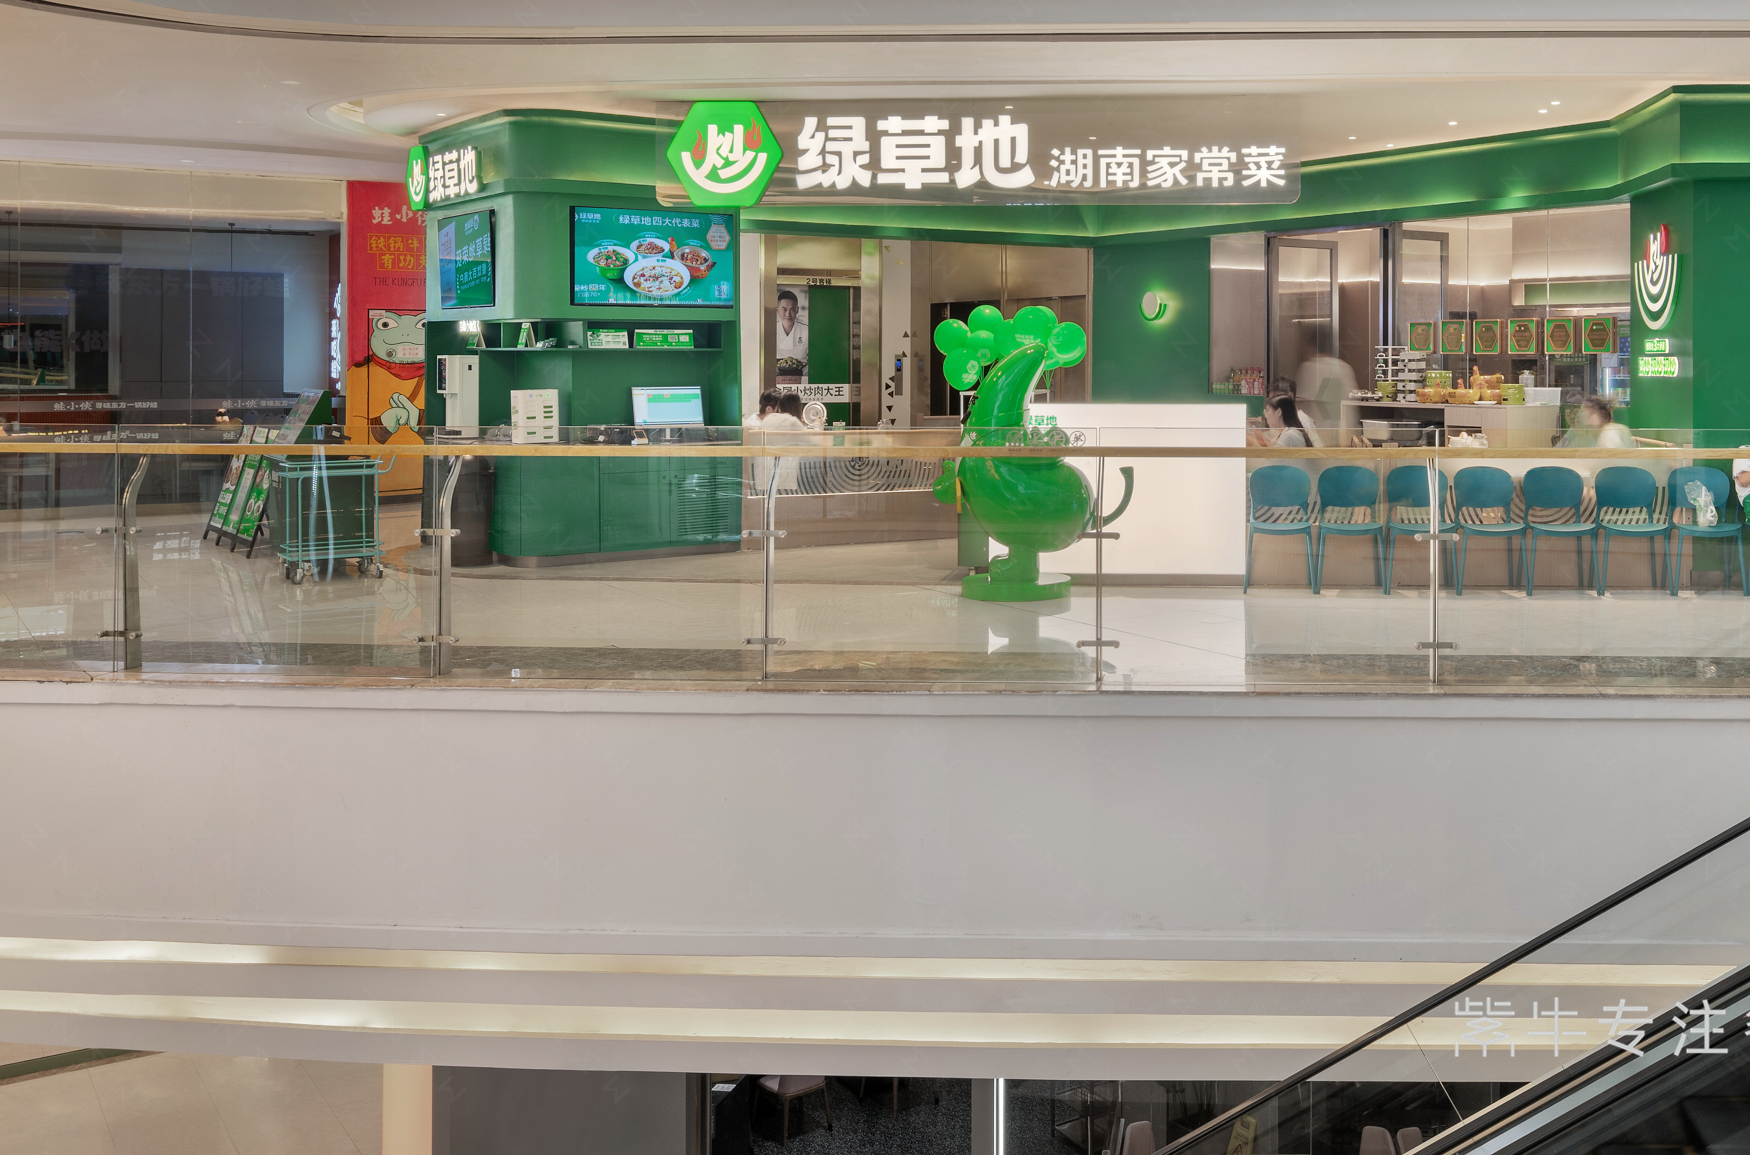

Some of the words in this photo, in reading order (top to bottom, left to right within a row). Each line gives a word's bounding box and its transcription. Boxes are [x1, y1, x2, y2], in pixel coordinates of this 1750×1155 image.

[796, 115, 1034, 189] 绿草地
[1048, 145, 1287, 188] 湖南家常菜
[428, 146, 478, 203] 绿草地
[619, 214, 700, 228] 绿草地四大代表菜
[373, 277, 389, 286] THE
[53, 401, 93, 412] 蛙小侠
[222, 399, 258, 409] 蛙小侠
